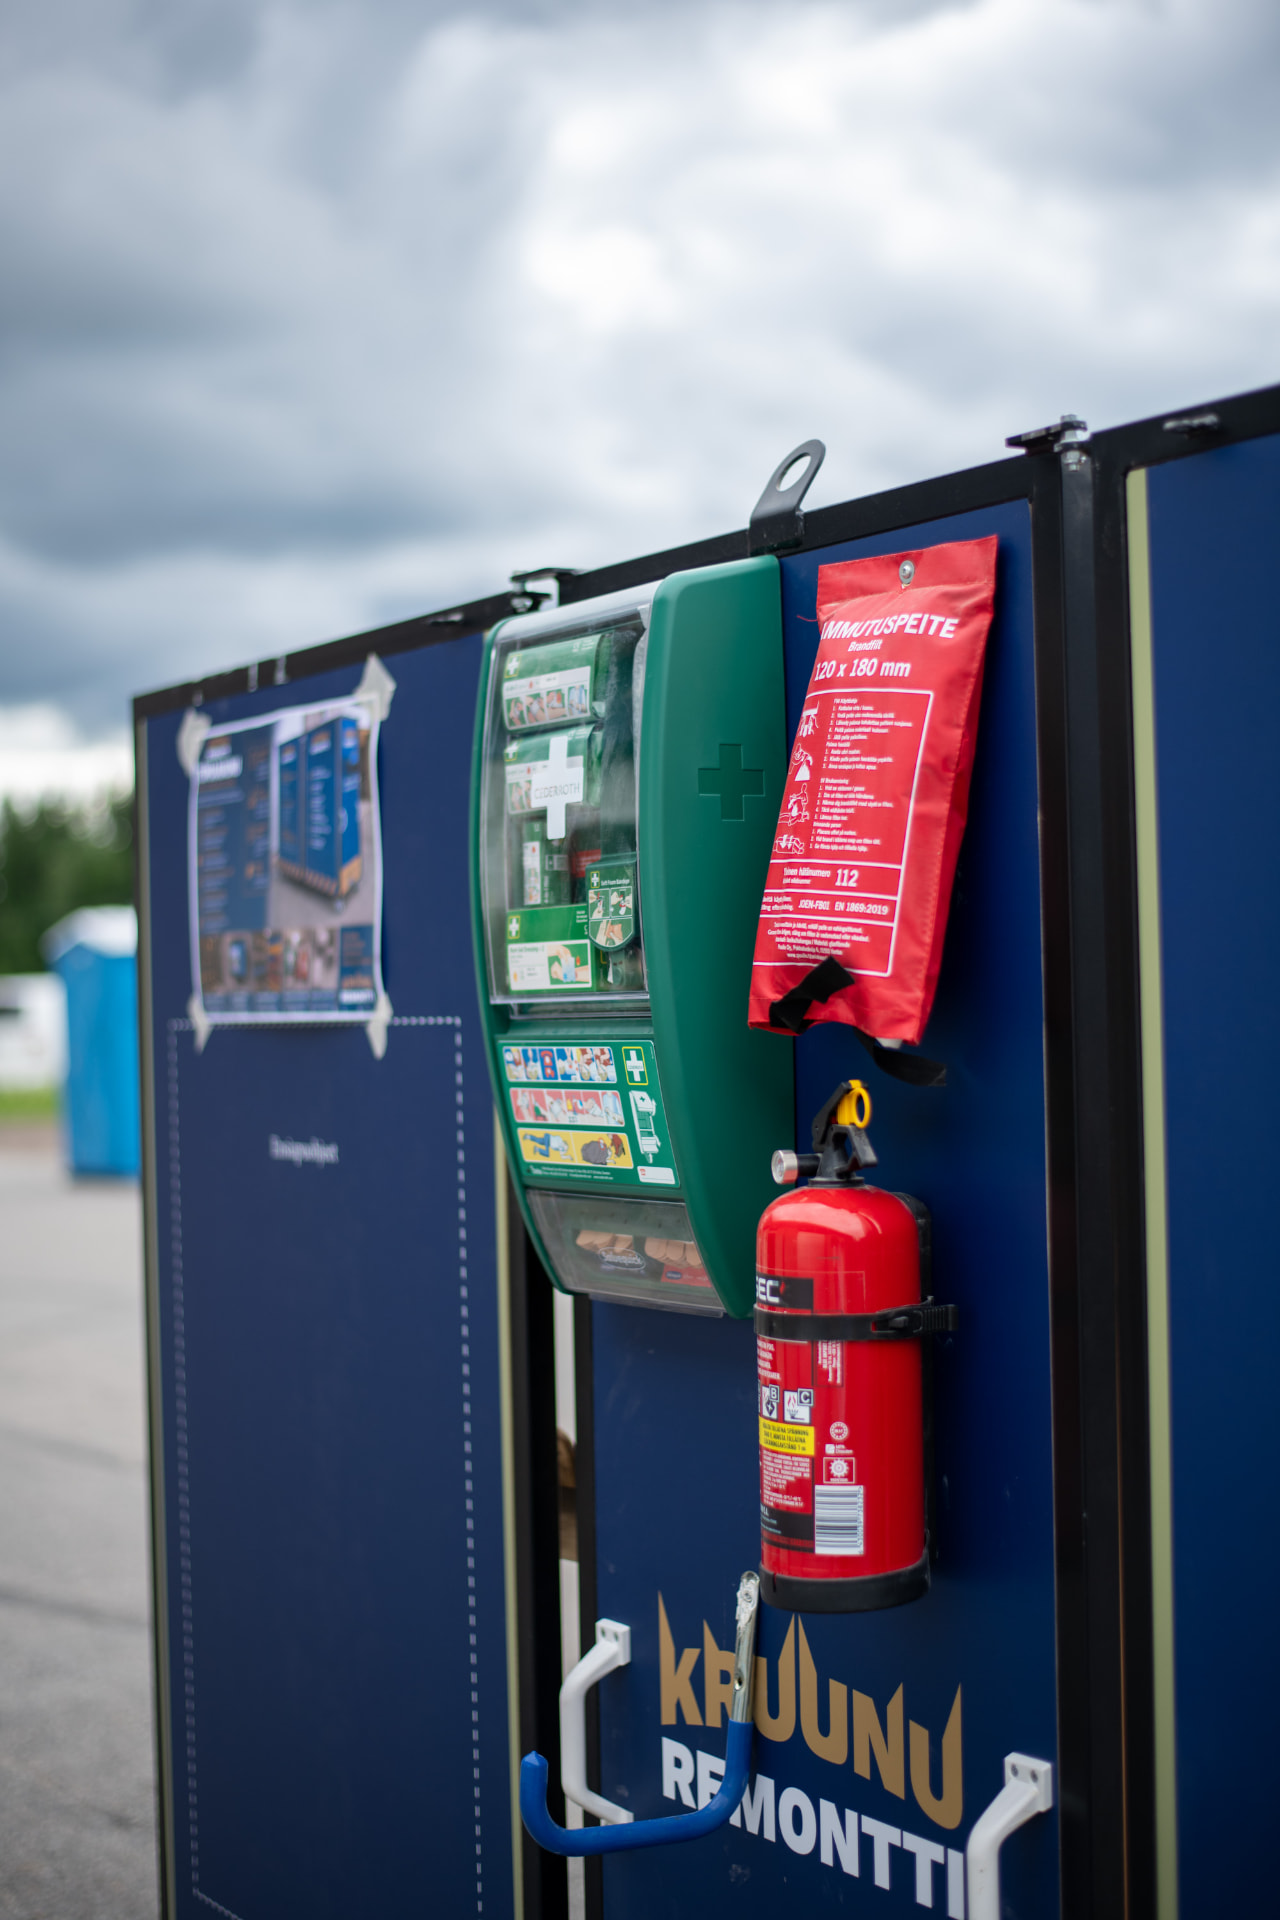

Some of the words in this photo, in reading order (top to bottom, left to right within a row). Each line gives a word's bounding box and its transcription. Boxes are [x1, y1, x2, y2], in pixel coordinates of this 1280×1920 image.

[848, 639, 882, 651] Brandfilt
[815, 660, 836, 681] 120
[837, 664, 848, 677] x
[849, 658, 878, 676] 180
[880, 662, 911, 677] mm
[835, 868, 858, 887] 112
[835, 901, 844, 911] EN
[846, 902, 888, 915] 1869:2019
[771, 1388, 777, 1398] B
[801, 1391, 809, 1403] C
[658, 1590, 963, 1830] KRUUNU
[662, 1736, 964, 1920] REMONTTI
